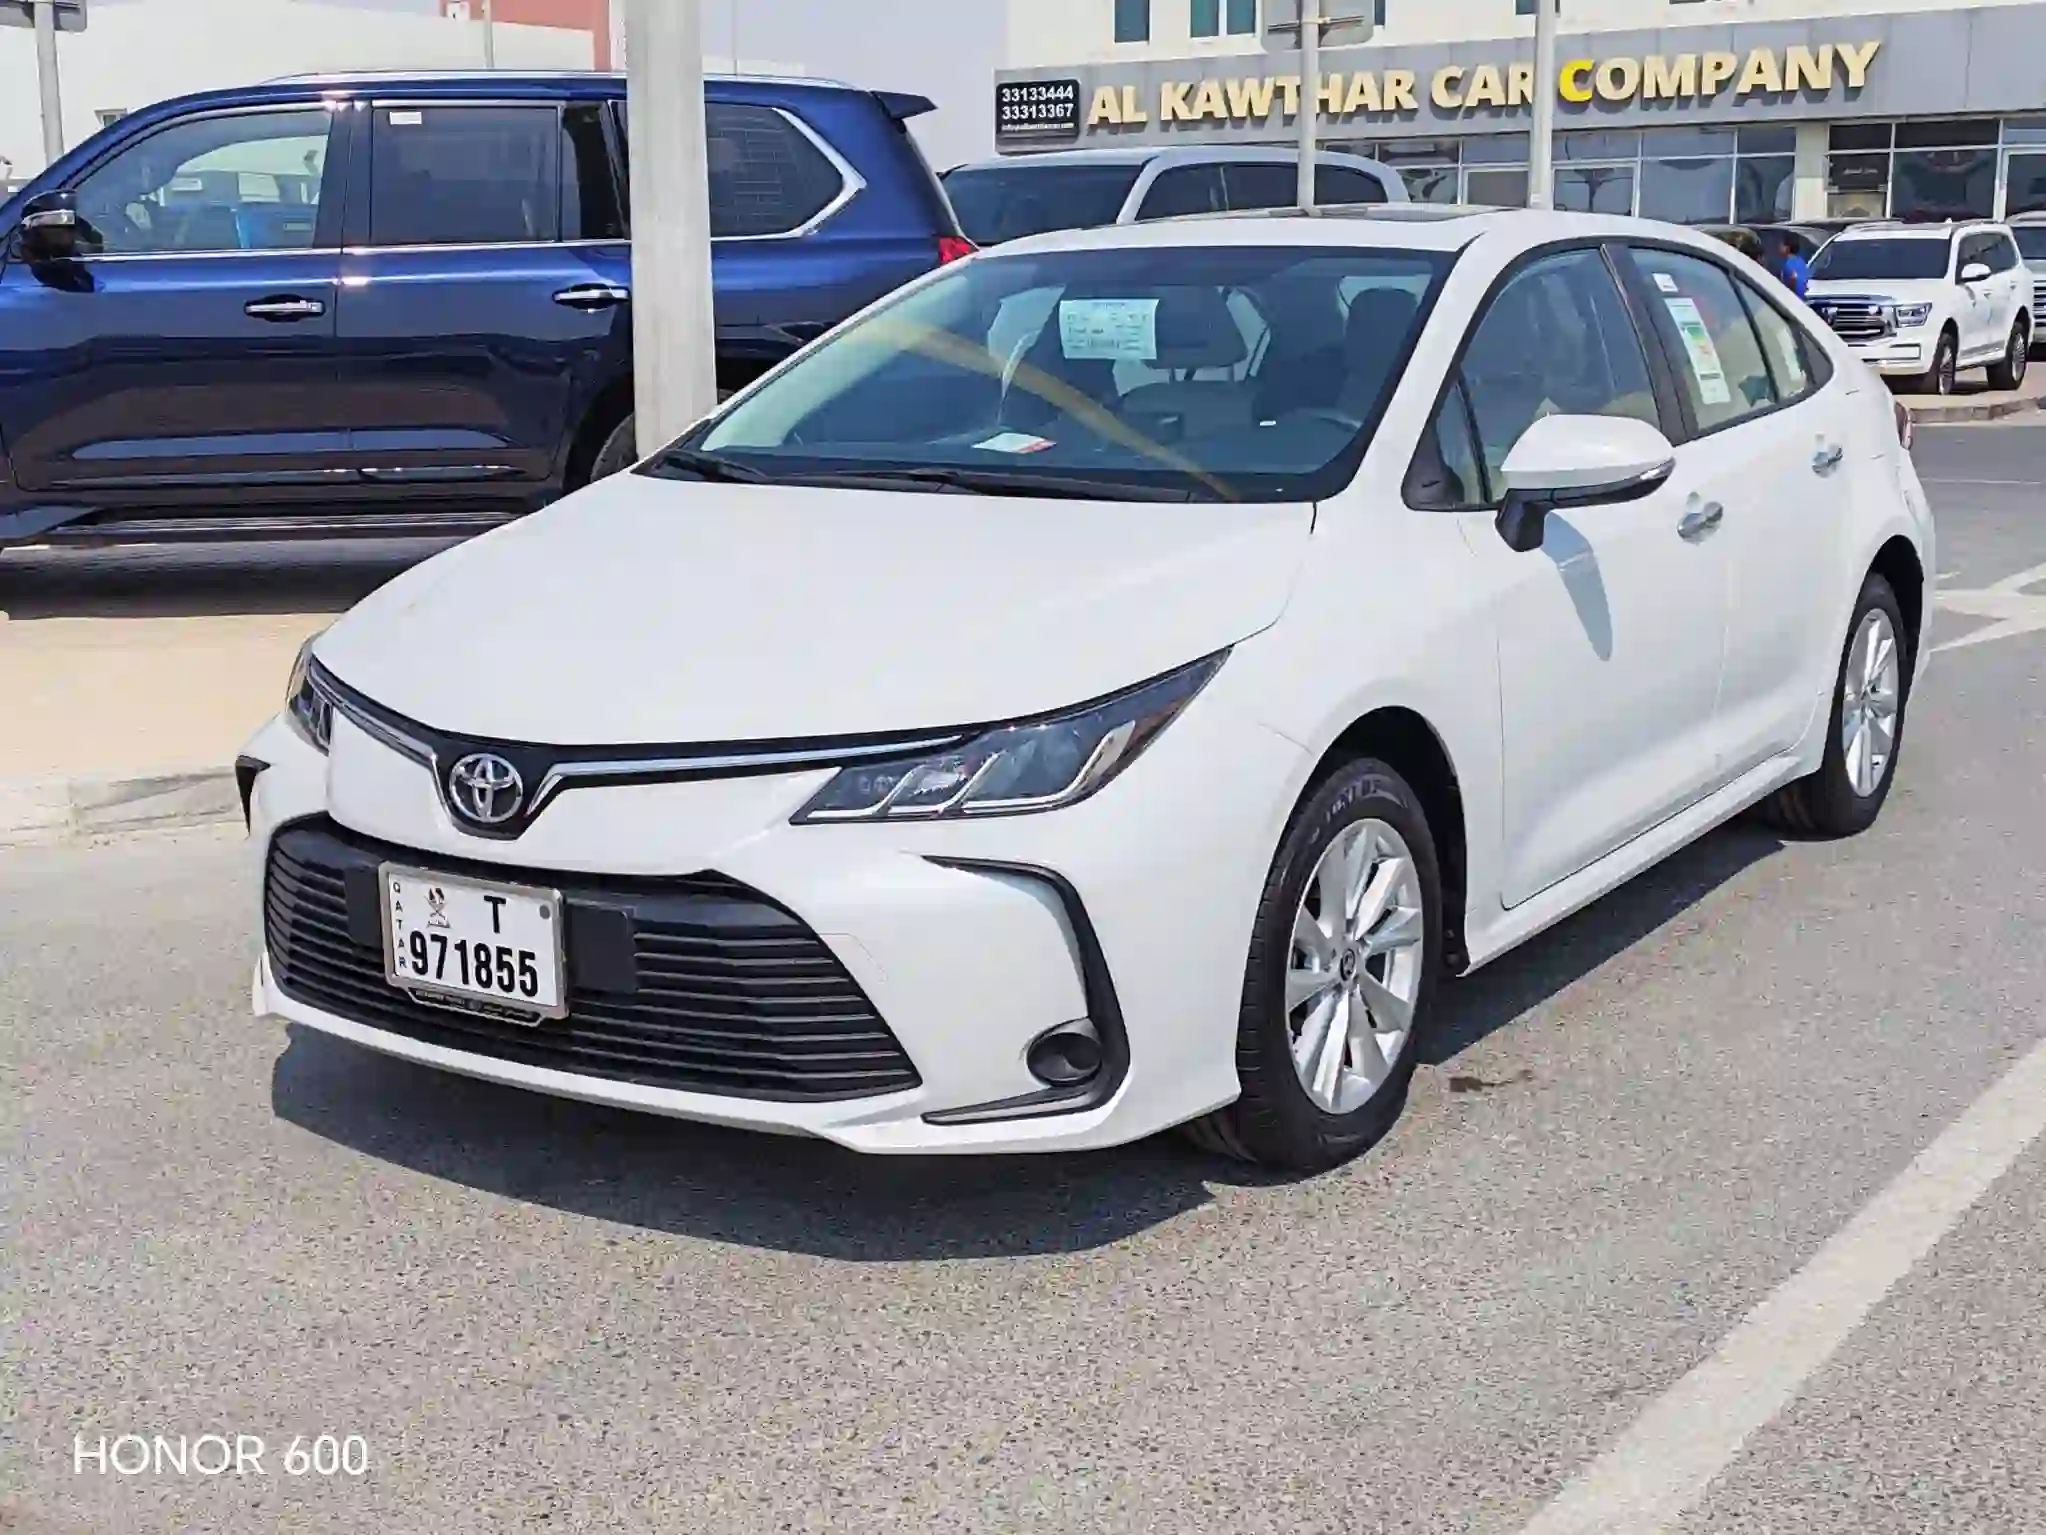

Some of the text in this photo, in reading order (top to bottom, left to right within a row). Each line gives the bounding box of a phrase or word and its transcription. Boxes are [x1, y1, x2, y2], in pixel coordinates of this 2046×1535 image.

[1002, 85, 1074, 102] 33133444
[1088, 39, 1881, 125] AL KAWTHAR CAR COMPANY
[1002, 103, 1074, 120] 33313367
[393, 881, 407, 969] QATAR
[483, 895, 507, 934] T
[410, 930, 539, 997] 971855
